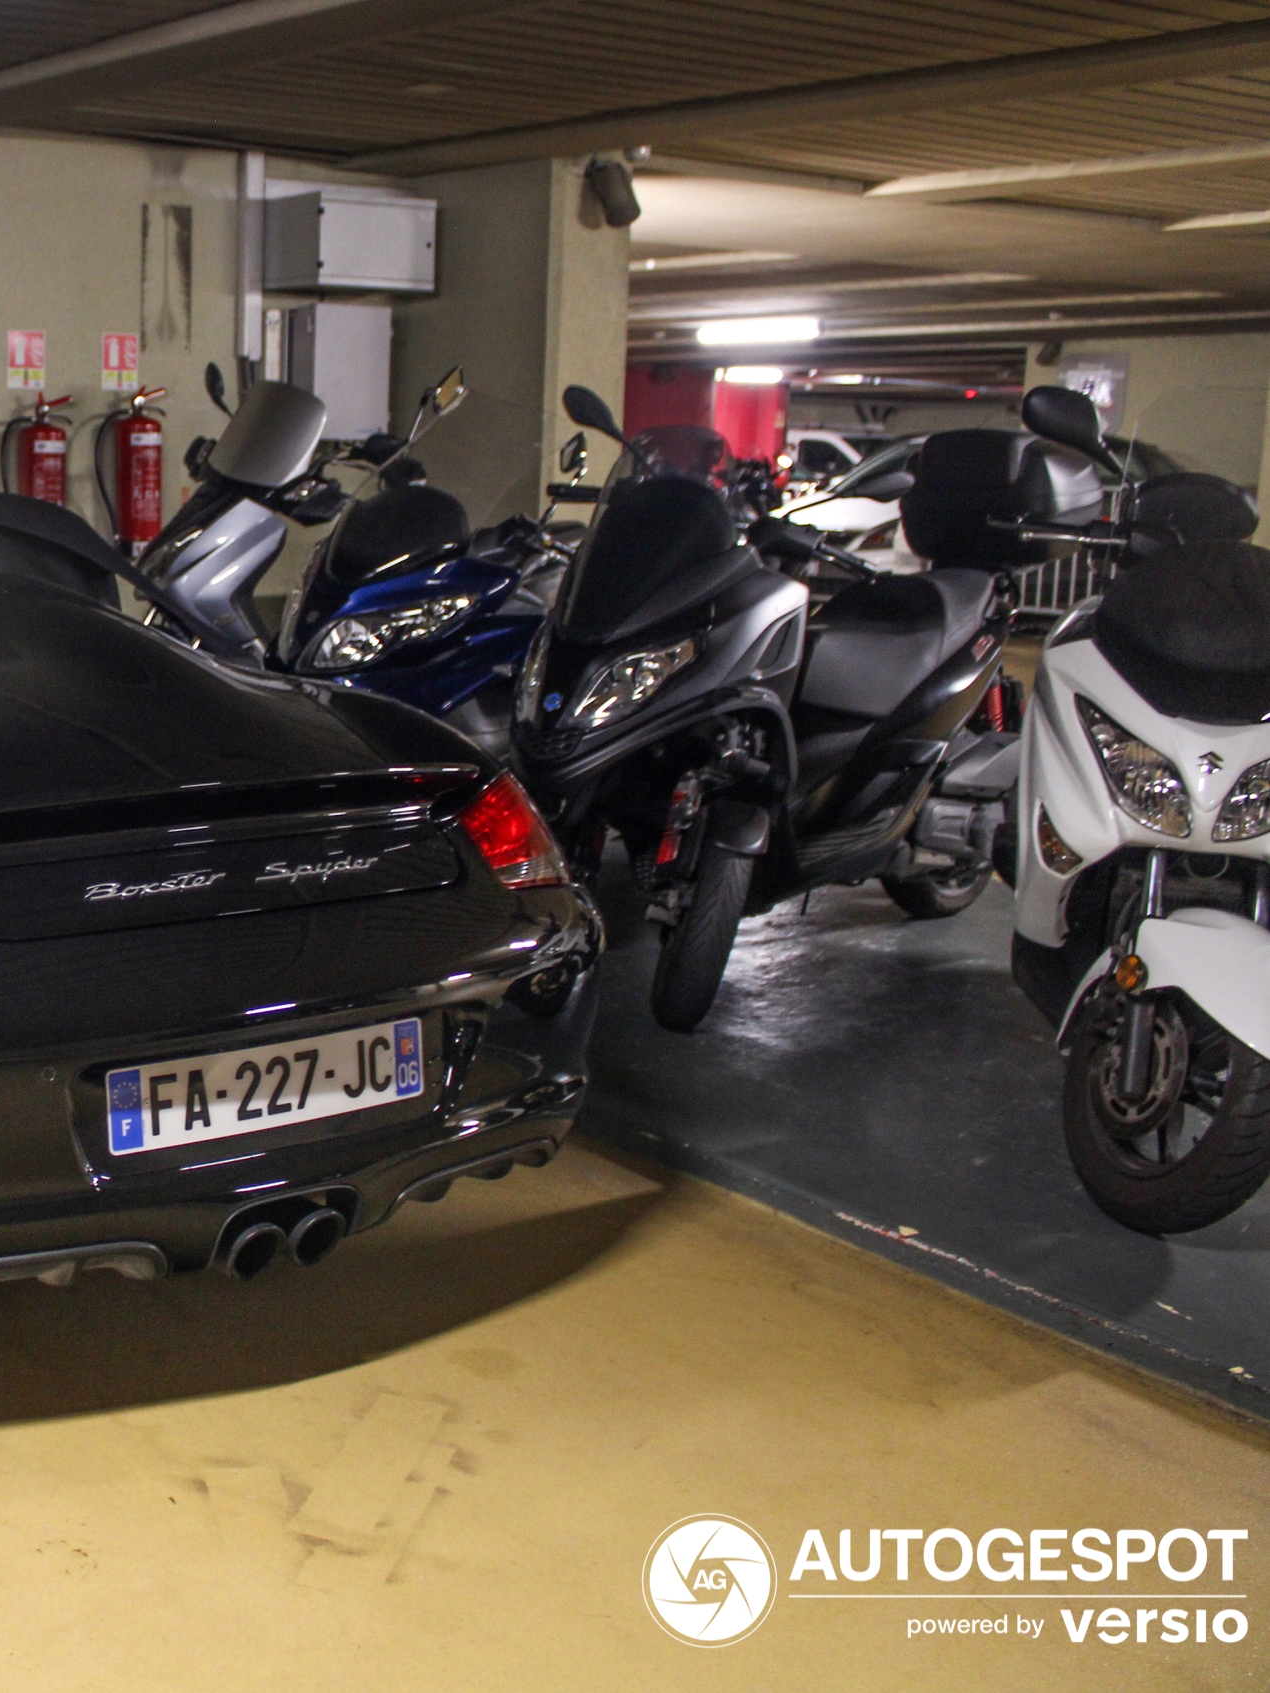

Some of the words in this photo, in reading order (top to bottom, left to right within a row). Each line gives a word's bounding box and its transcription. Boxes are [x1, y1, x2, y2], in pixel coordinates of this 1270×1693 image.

[84, 871, 226, 902] Boxster
[255, 855, 378, 885] Spyder
[148, 1035, 393, 1137] FA-227-JC
[397, 1061, 419, 1089] 06
[121, 1118, 132, 1137] F
